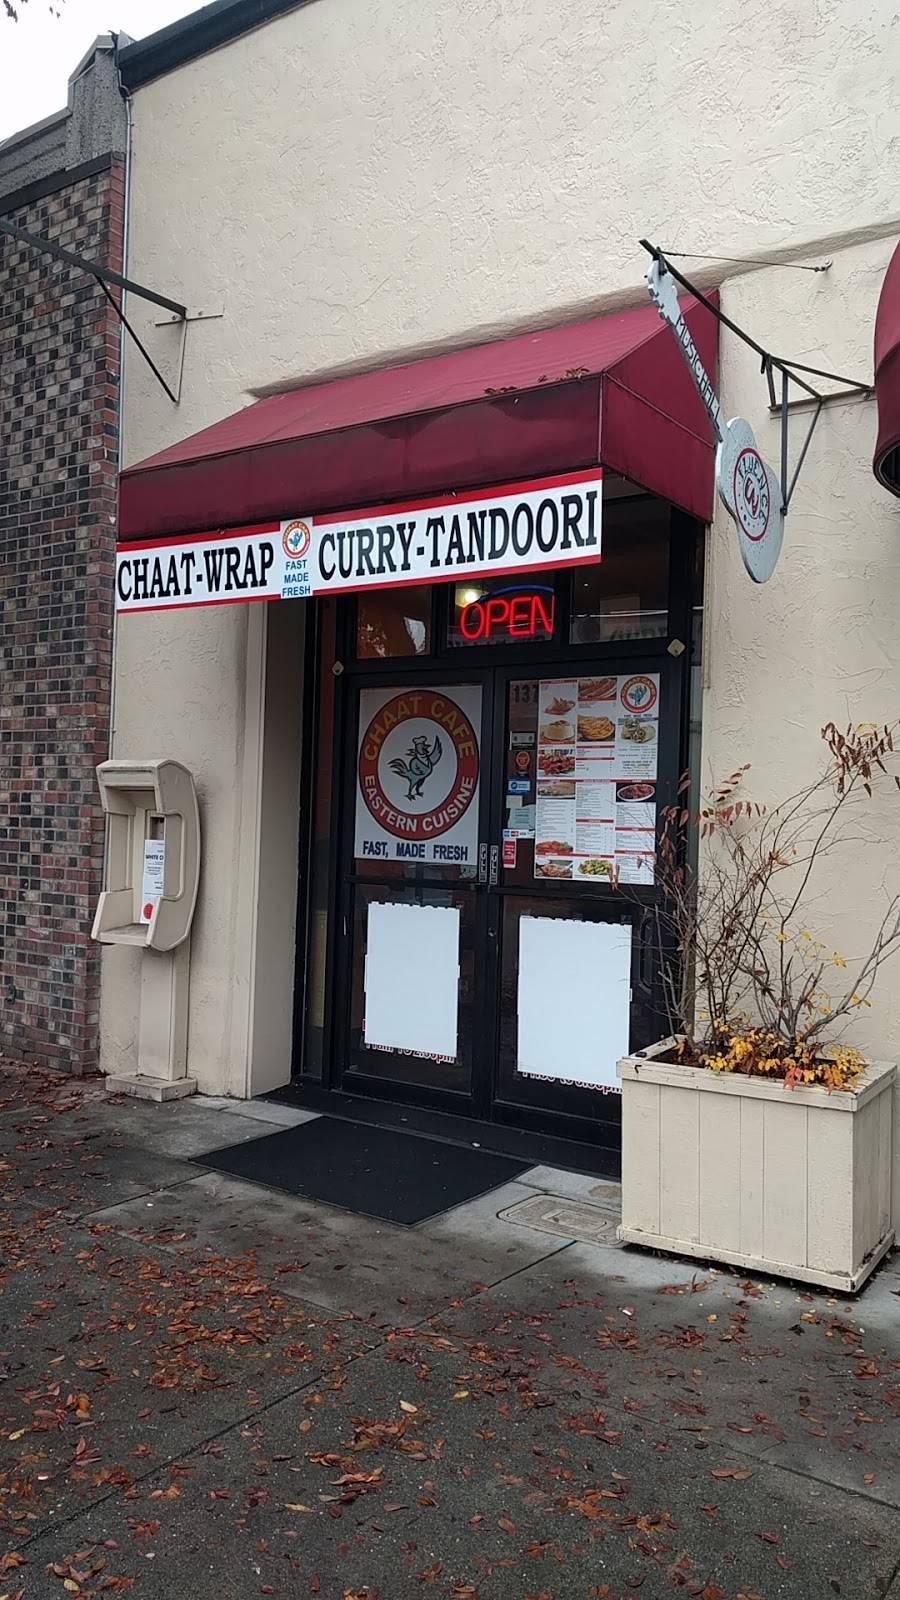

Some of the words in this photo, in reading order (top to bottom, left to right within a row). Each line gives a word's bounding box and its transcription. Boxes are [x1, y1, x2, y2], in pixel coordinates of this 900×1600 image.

[318, 490, 599, 581] CURRY-TANDOORI
[117, 541, 274, 601] CHAAT-WRAP
[284, 572, 309, 584] MADE
[285, 559, 307, 570] FAST
[282, 585, 311, 597] FRESH
[459, 595, 555, 640] OPEN
[364, 696, 424, 761] CHAAT
[430, 700, 476, 758] CAFE
[364, 774, 417, 833] EASTERN
[422, 775, 474, 832] CUISINE
[362, 840, 389, 858] FAST,
[396, 842, 426, 859] MADE
[433, 844, 468, 861] FRESH
